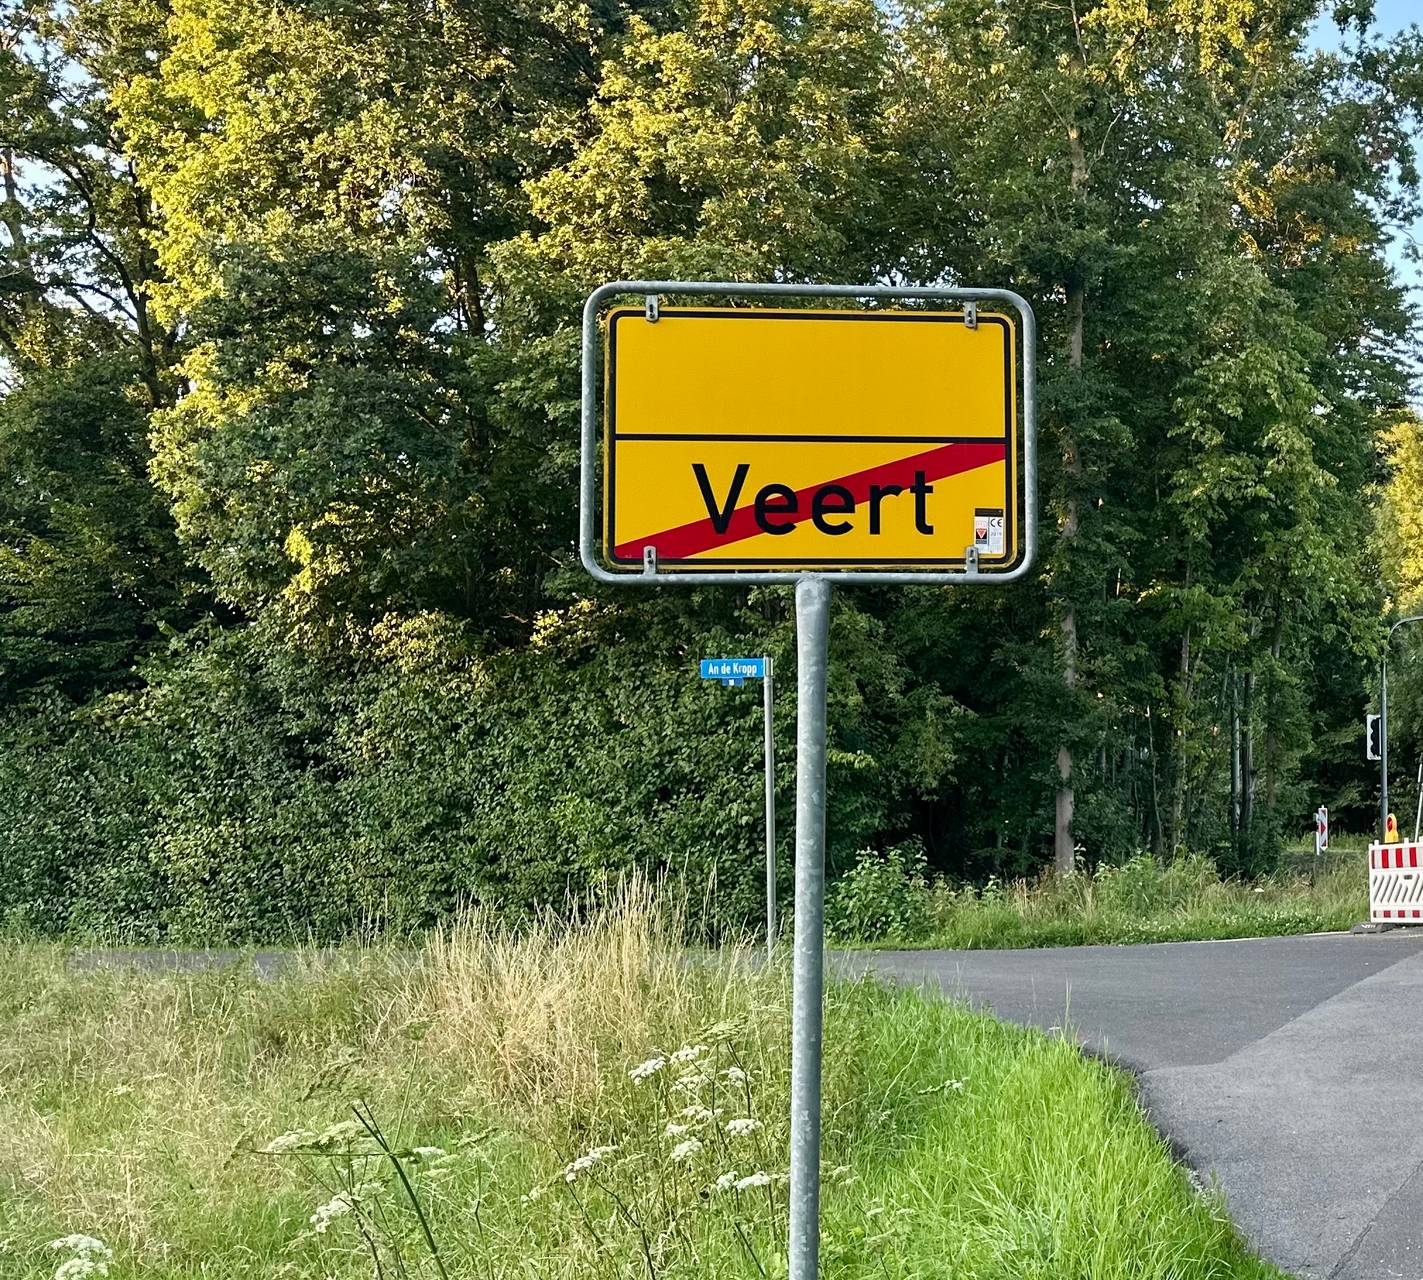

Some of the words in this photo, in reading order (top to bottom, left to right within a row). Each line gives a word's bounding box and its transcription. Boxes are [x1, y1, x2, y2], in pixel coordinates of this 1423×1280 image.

[691, 463, 935, 536] Veert
[708, 663, 719, 675] An
[721, 663, 731, 674] de
[733, 662, 757, 676] Kropp
